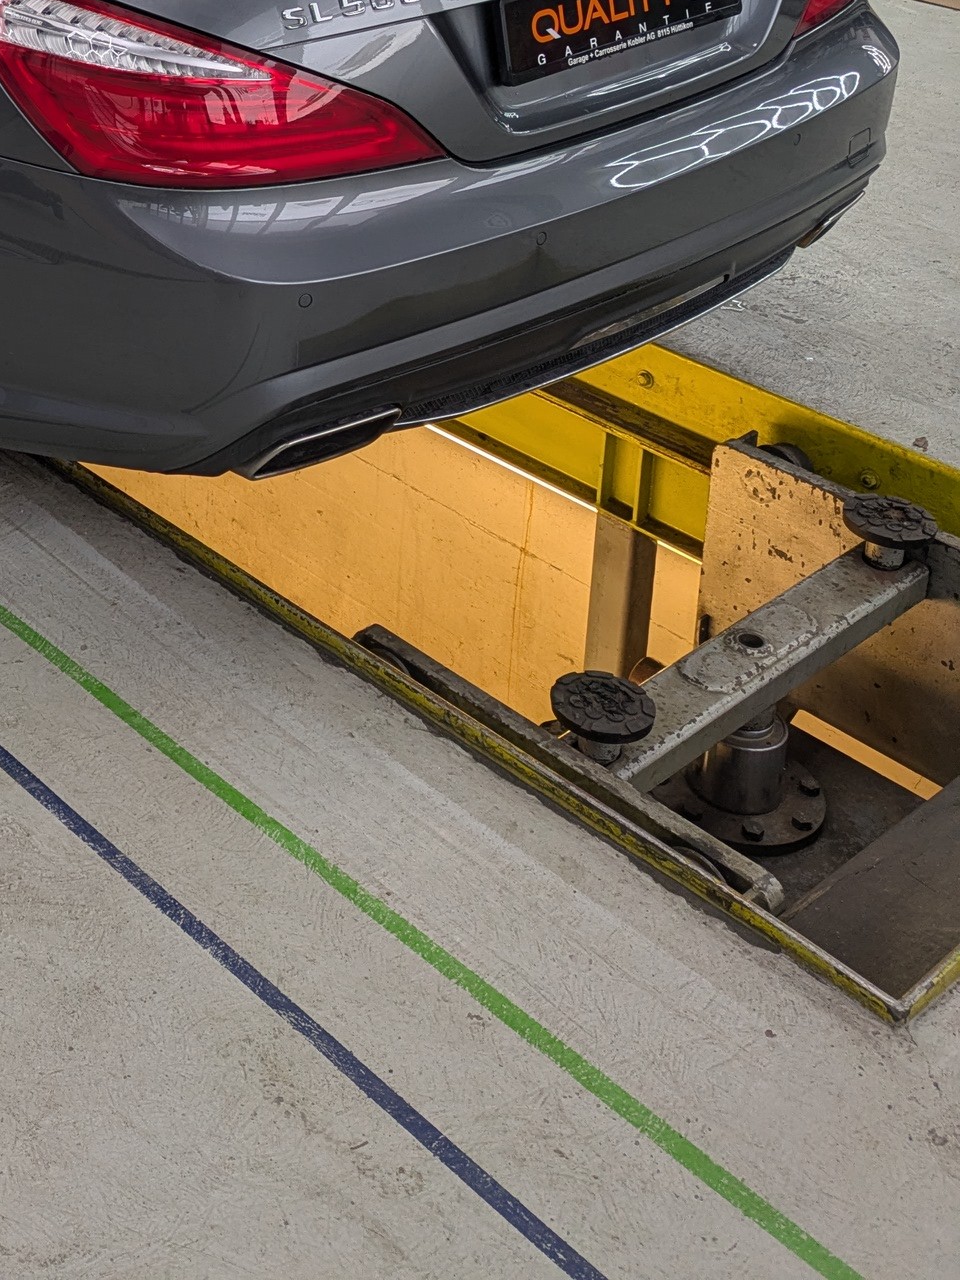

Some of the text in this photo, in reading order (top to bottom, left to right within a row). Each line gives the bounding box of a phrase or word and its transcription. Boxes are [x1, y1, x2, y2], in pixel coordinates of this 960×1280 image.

[567, 52, 590, 67] Garage
[594, 40, 628, 58] Carrosserie
[627, 35, 646, 48] Kobler
[646, 32, 656, 42] AG
[657, 29, 671, 38] 8115
